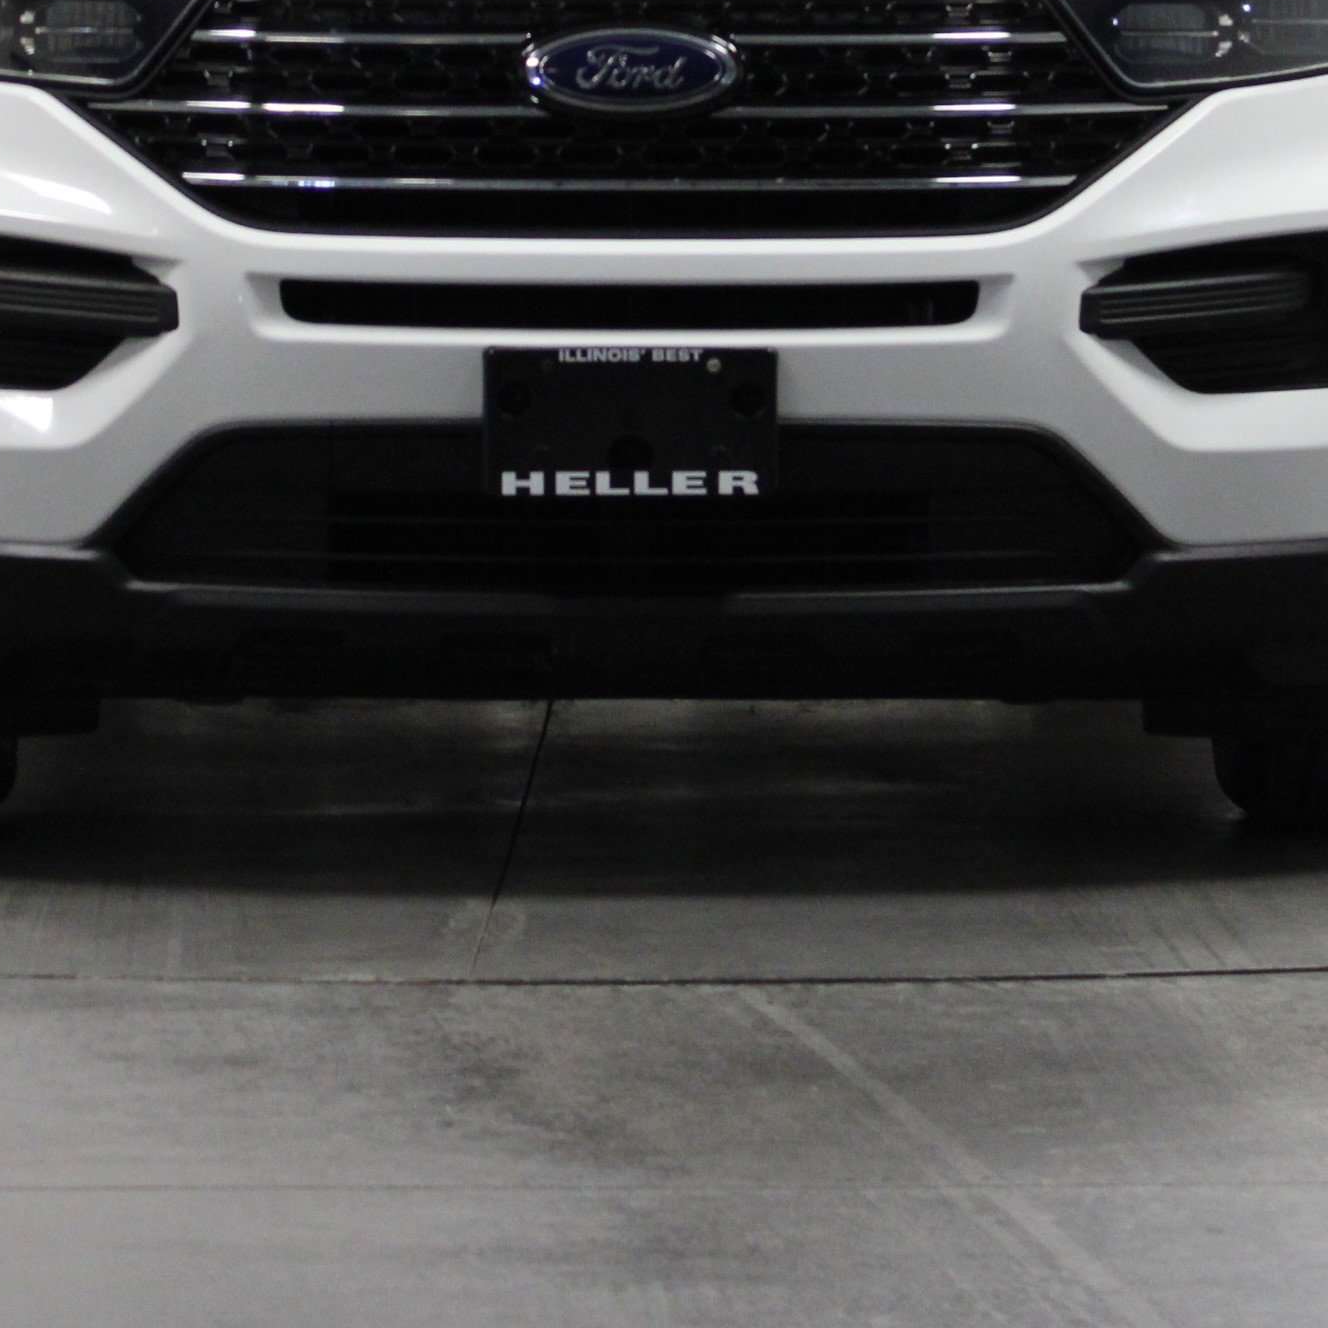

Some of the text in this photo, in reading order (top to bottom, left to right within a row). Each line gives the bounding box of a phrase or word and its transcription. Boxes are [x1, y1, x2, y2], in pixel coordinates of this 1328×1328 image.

[576, 44, 687, 89] Ford
[558, 348, 703, 363] ILLINOIS' BEST
[501, 470, 759, 496] HELLER
